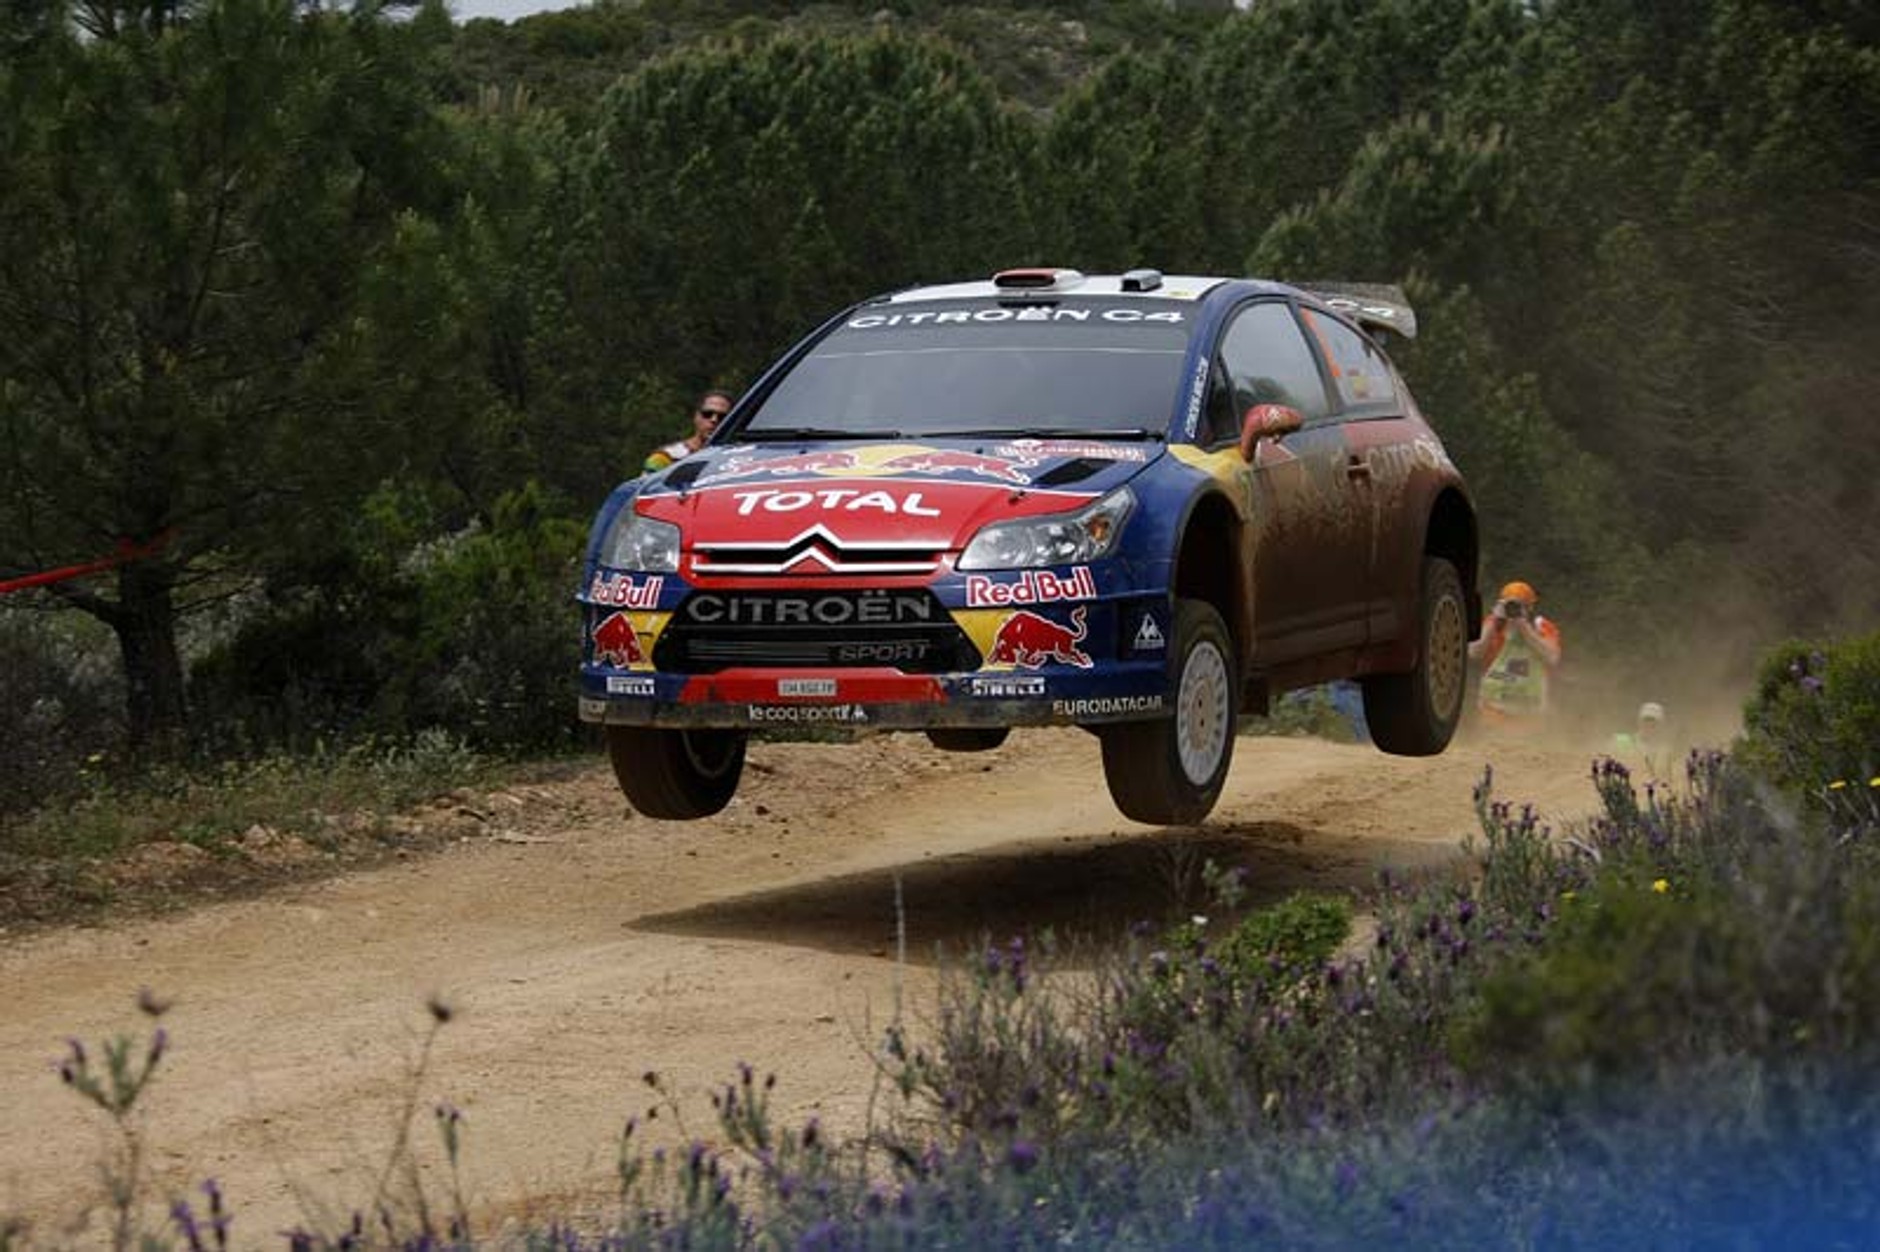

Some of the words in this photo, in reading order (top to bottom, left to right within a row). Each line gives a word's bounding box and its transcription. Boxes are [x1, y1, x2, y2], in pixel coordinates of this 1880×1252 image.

[1101, 309, 1185, 323] C4
[733, 490, 941, 516] TOTAL
[614, 575, 664, 609] Bull
[966, 572, 1034, 607] Red
[1036, 567, 1097, 604] Bull
[687, 590, 930, 623] CITROËN
[838, 643, 928, 662] SPORT
[749, 704, 764, 720] le
[766, 706, 798, 722] coq
[800, 704, 850, 721] sportif
[1053, 696, 1162, 716] EURODATACAR
